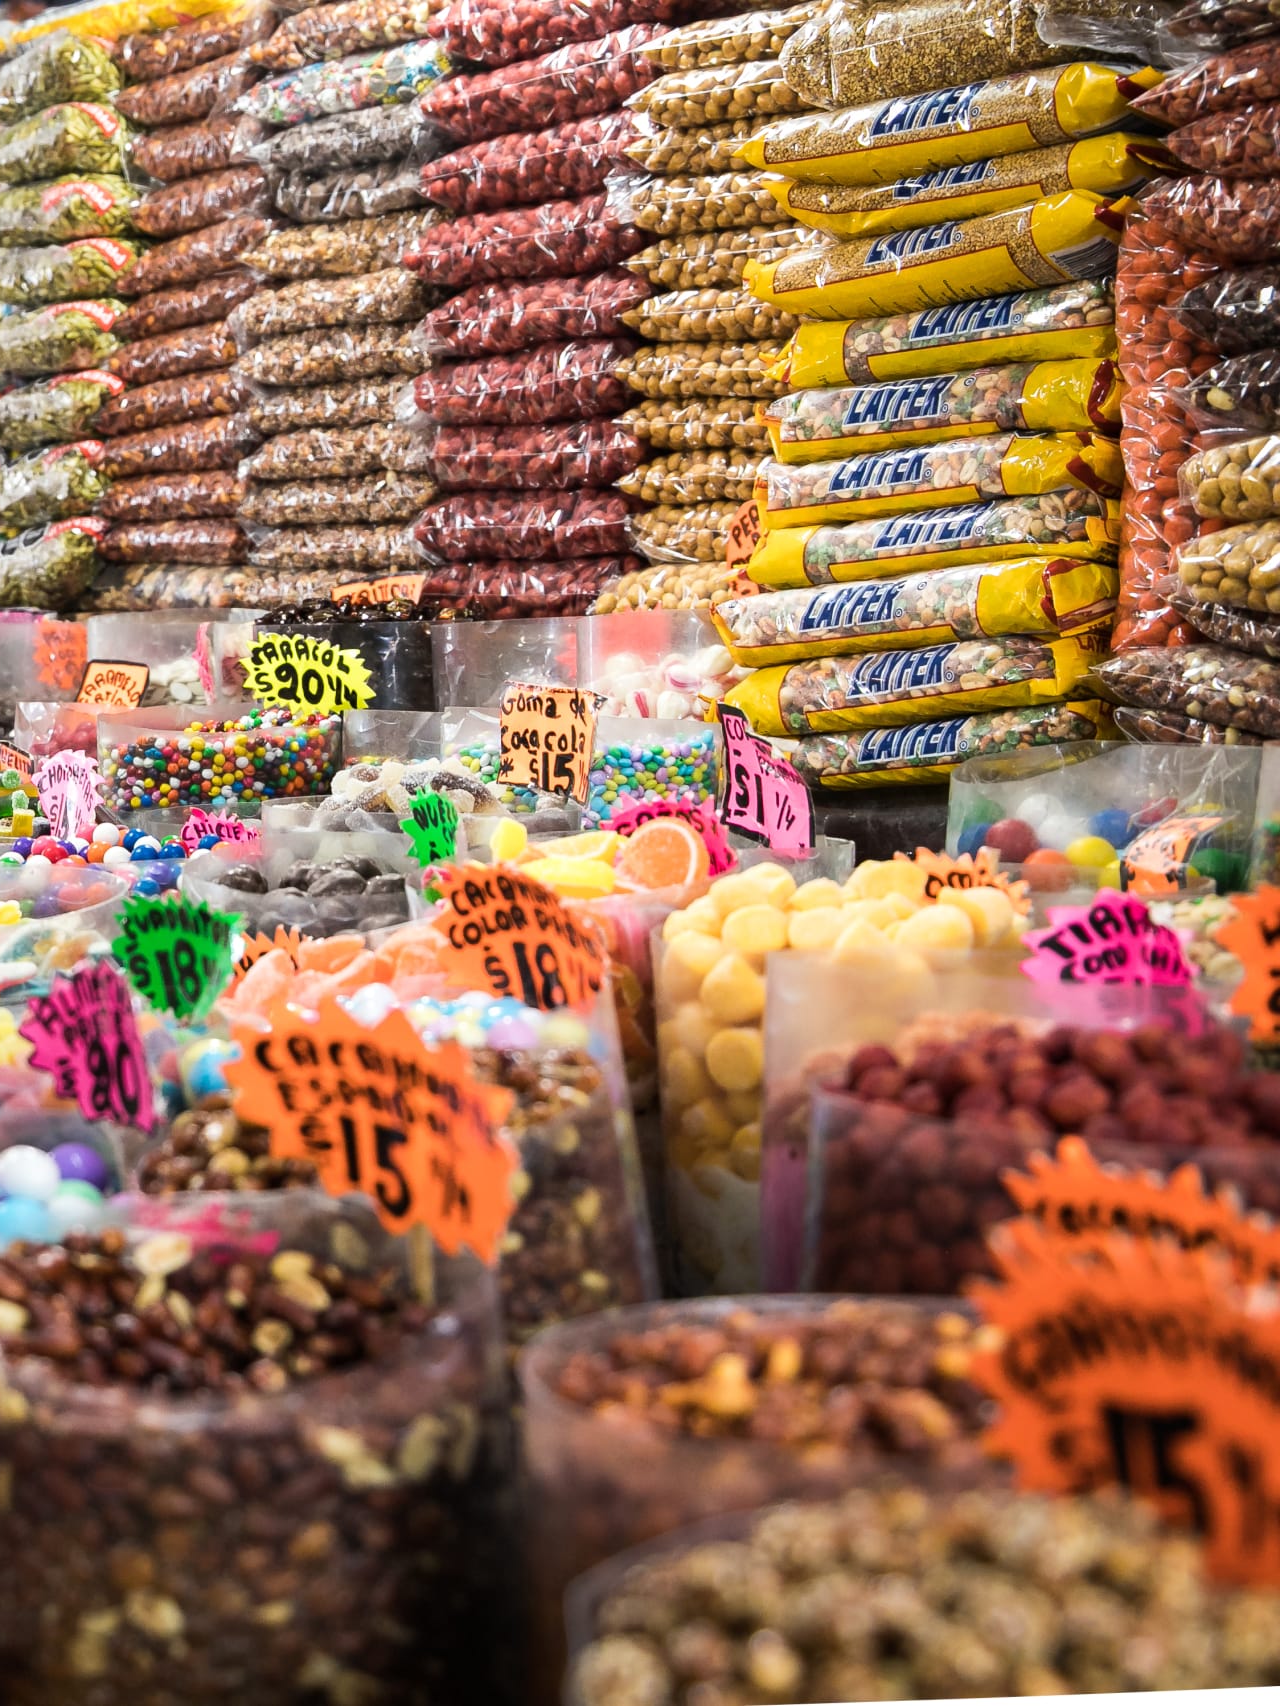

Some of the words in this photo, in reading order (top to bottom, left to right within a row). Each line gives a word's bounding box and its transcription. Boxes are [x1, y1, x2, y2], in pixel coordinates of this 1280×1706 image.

[908, 296, 1022, 341] LAYFER
[843, 375, 958, 425] LAYFER
[828, 458, 930, 493] LAYFER
[872, 501, 995, 551] LAYFER
[798, 581, 906, 632] LAYFER
[251, 636, 351, 675] CARACOL
[846, 642, 961, 699] LAYFER
[857, 715, 972, 765] LAYFER
[449, 904, 528, 950] COLOR
